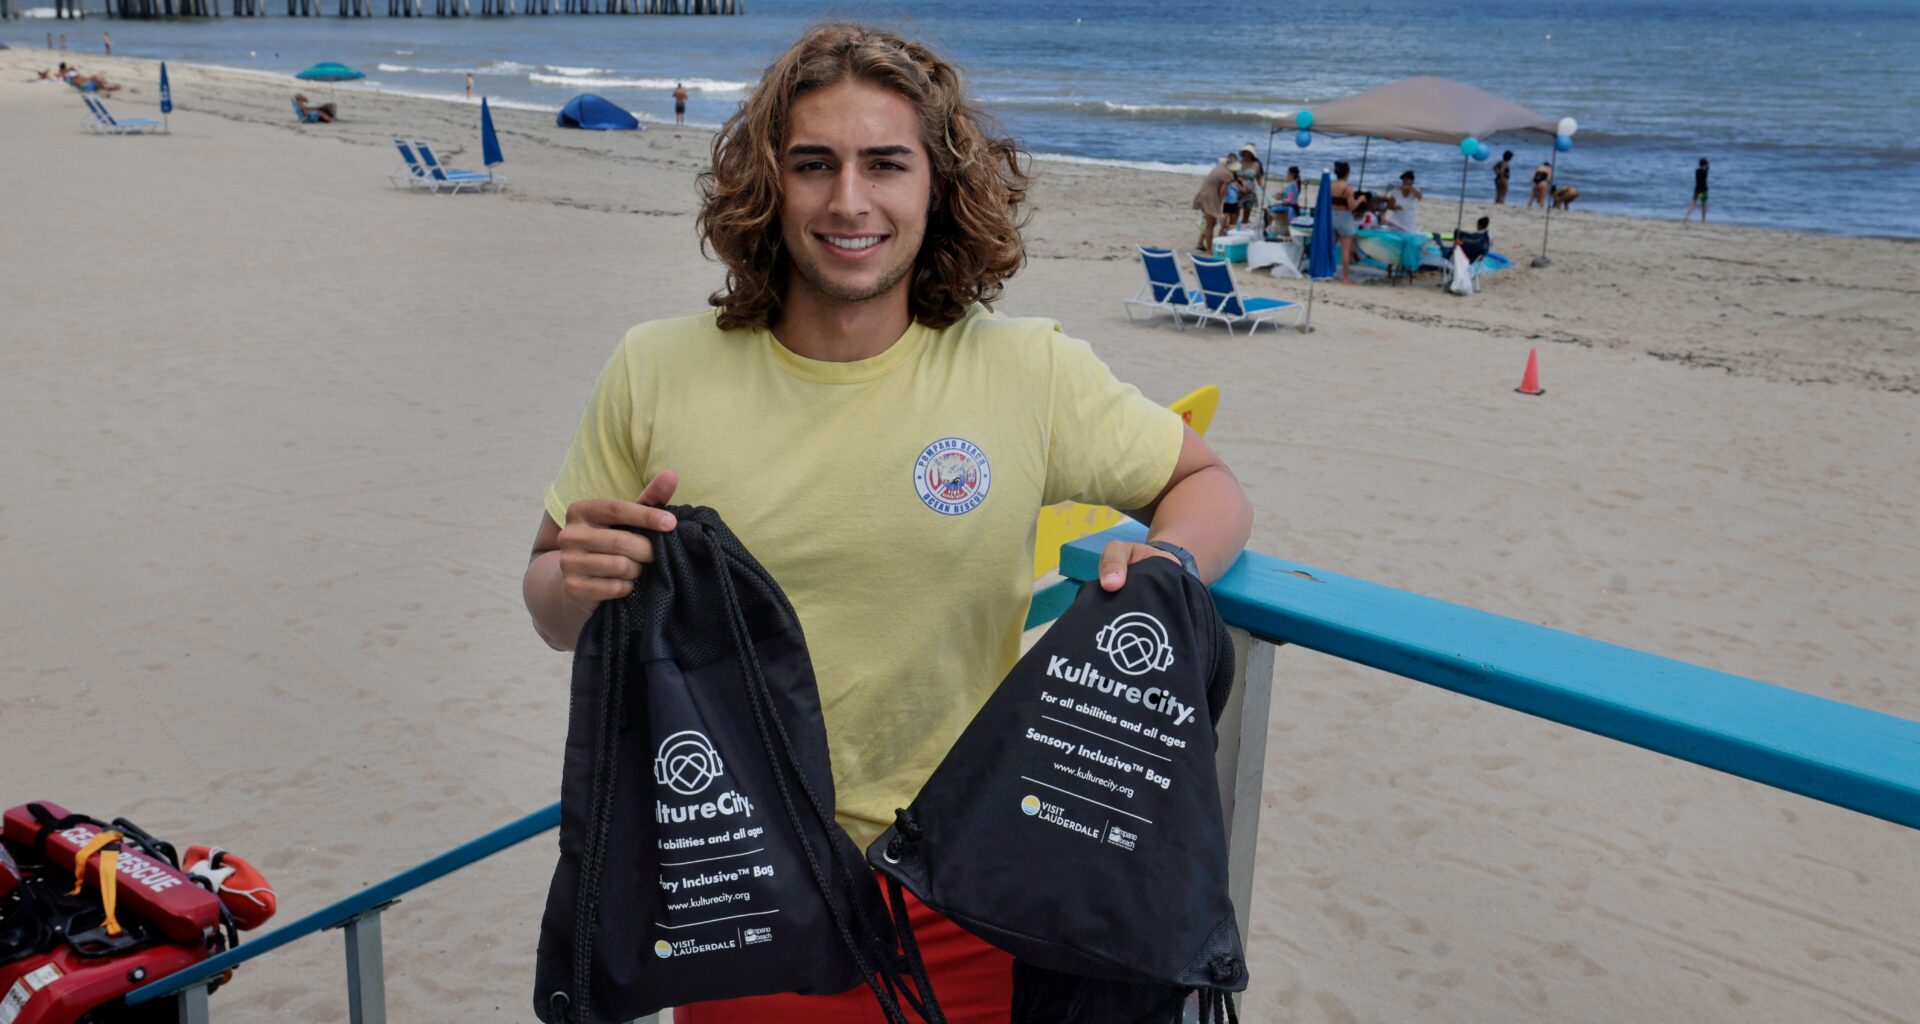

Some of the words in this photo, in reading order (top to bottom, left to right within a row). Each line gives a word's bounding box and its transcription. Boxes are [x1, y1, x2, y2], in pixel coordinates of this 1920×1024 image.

[918, 440, 957, 467] POMPANO
[960, 441, 986, 466] BEACH
[923, 492, 950, 513] OCEAN
[954, 491, 984, 513] RESCUE
[1040, 691, 1058, 703] For
[1059, 697, 1073, 709] all
[1075, 703, 1118, 724] abilities
[1119, 719, 1142, 733] and
[1143, 727, 1159, 739] all
[1160, 733, 1186, 748] ages
[1025, 727, 1076, 755] Sensory
[1145, 768, 1171, 790] Bag
[1053, 762, 1134, 798] www.kulturecity.org
[1042, 801, 1065, 816] VISIT
[1038, 810, 1100, 839] LAUDERDALE
[663, 837, 706, 850] abilities
[708, 831, 730, 845] and
[733, 828, 746, 840] all
[747, 827, 763, 838] ages
[659, 877, 679, 893] ory
[753, 865, 774, 878] Bag
[667, 892, 751, 911] www.kulturecity.org
[672, 939, 696, 949] VISIT
[673, 940, 736, 957] LAUDERDALE
